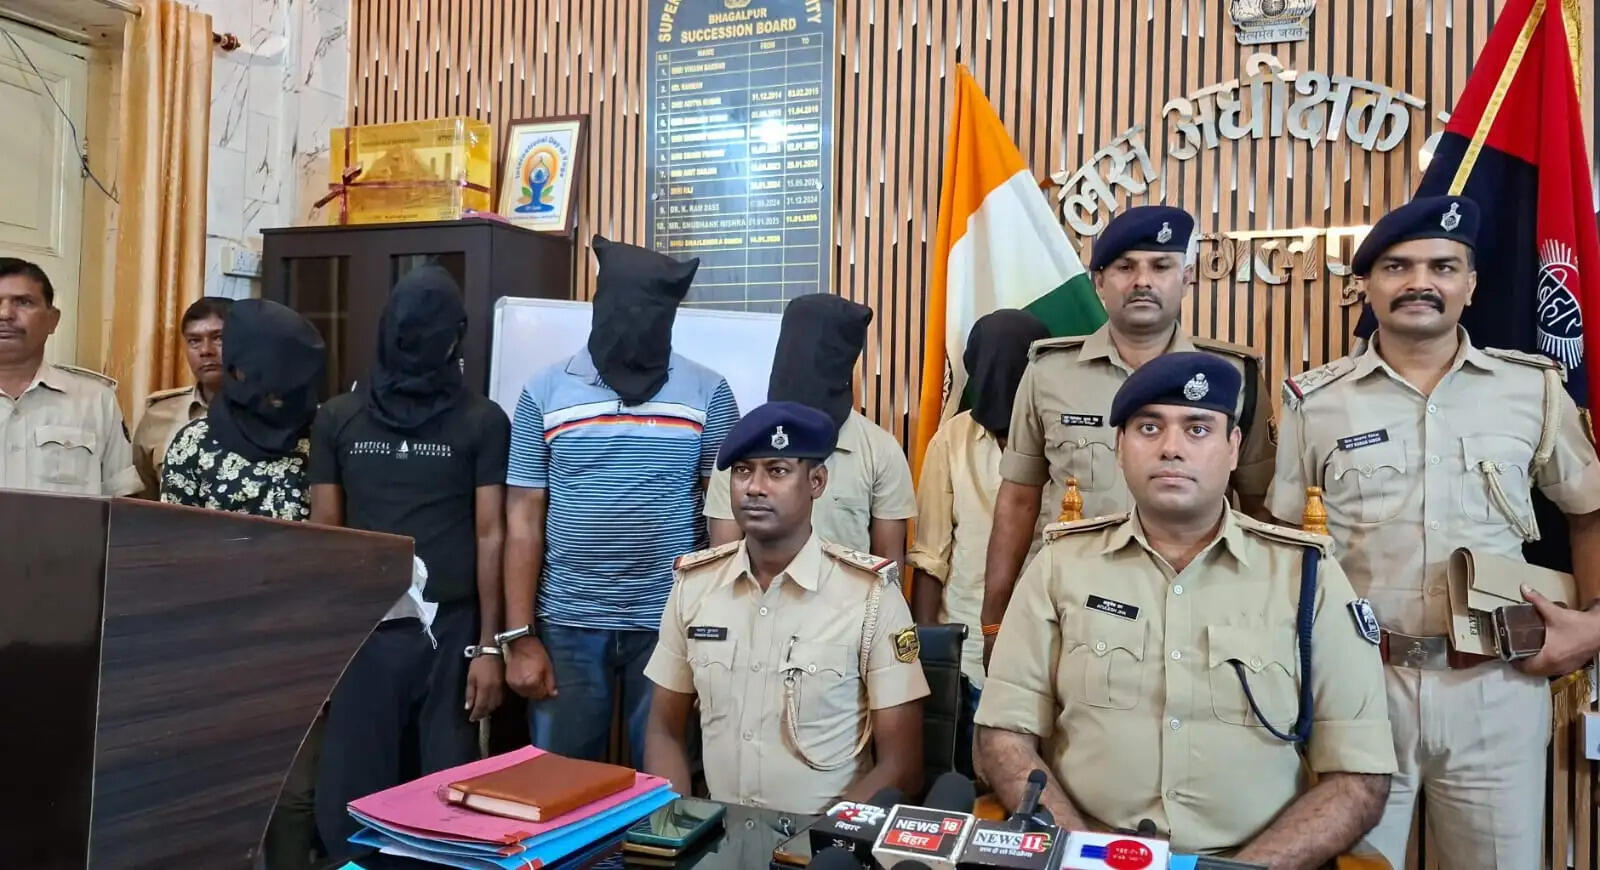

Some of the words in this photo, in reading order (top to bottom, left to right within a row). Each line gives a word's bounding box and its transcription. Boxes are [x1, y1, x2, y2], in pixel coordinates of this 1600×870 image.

[708, 8, 767, 24] BHAGALPUR
[681, 23, 753, 43] SUCCESSION
[756, 18, 797, 34] BOARD
[1162, 52, 1426, 161] अधीक्षक
[895, 819, 940, 833] NEWS
[943, 820, 957, 832] 18
[897, 831, 930, 846] बिहार
[975, 831, 1021, 846] NEWS
[1023, 835, 1042, 850] 11
